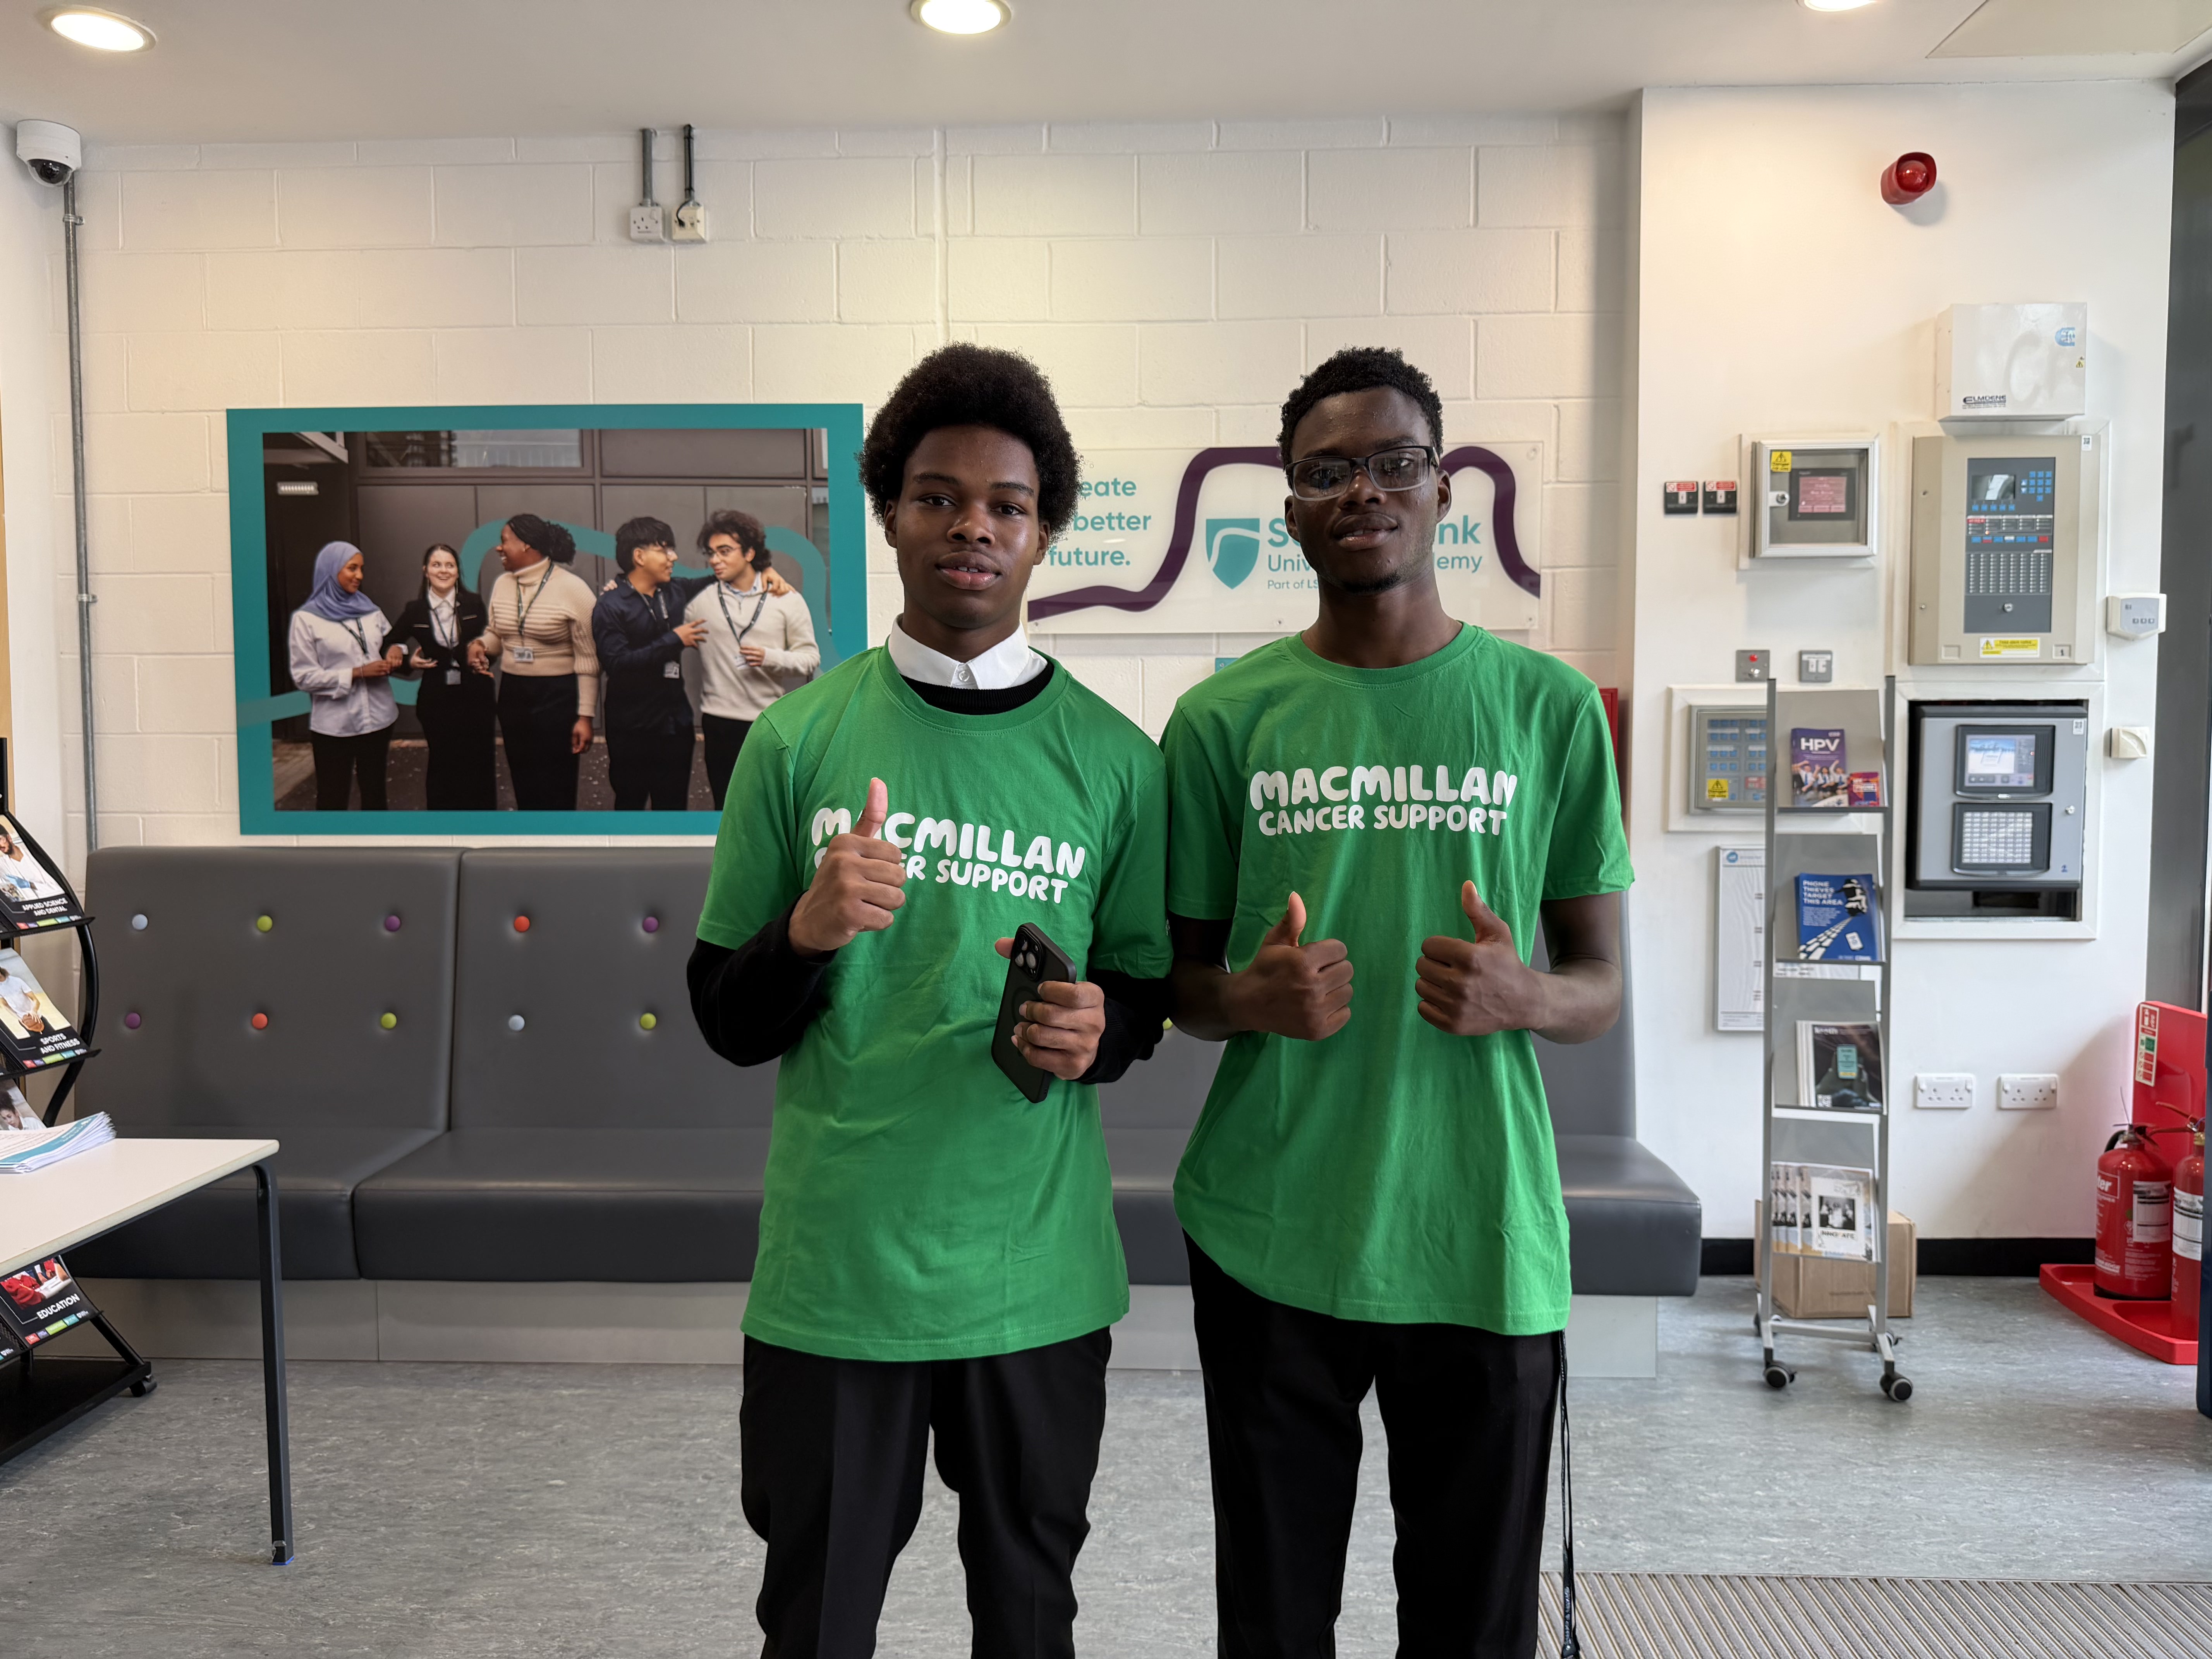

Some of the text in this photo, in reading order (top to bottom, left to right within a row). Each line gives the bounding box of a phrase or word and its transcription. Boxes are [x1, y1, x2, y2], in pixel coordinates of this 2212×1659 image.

[1080, 477, 1137, 497] eate
[1073, 511, 1151, 531] better
[1439, 515, 1481, 544] nk
[1048, 545, 1131, 566] future.
[1267, 579, 1318, 589] Part of LS
[1800, 737, 1840, 752] HPV
[1250, 765, 1517, 811] MACMILLAN
[1259, 804, 1507, 836] CANCER SUPPORT
[812, 807, 1085, 879] MCMILLAN
[935, 859, 1068, 903] SUPPORT
[43, 898, 68, 907] SCIENCE
[46, 905, 68, 915] DENTAL
[40, 1033, 67, 1045] SPORTS
[40, 1038, 81, 1054] AND FITNESS
[2097, 1175, 2112, 1192] ter
[37, 1293, 81, 1320] EDUCATION
